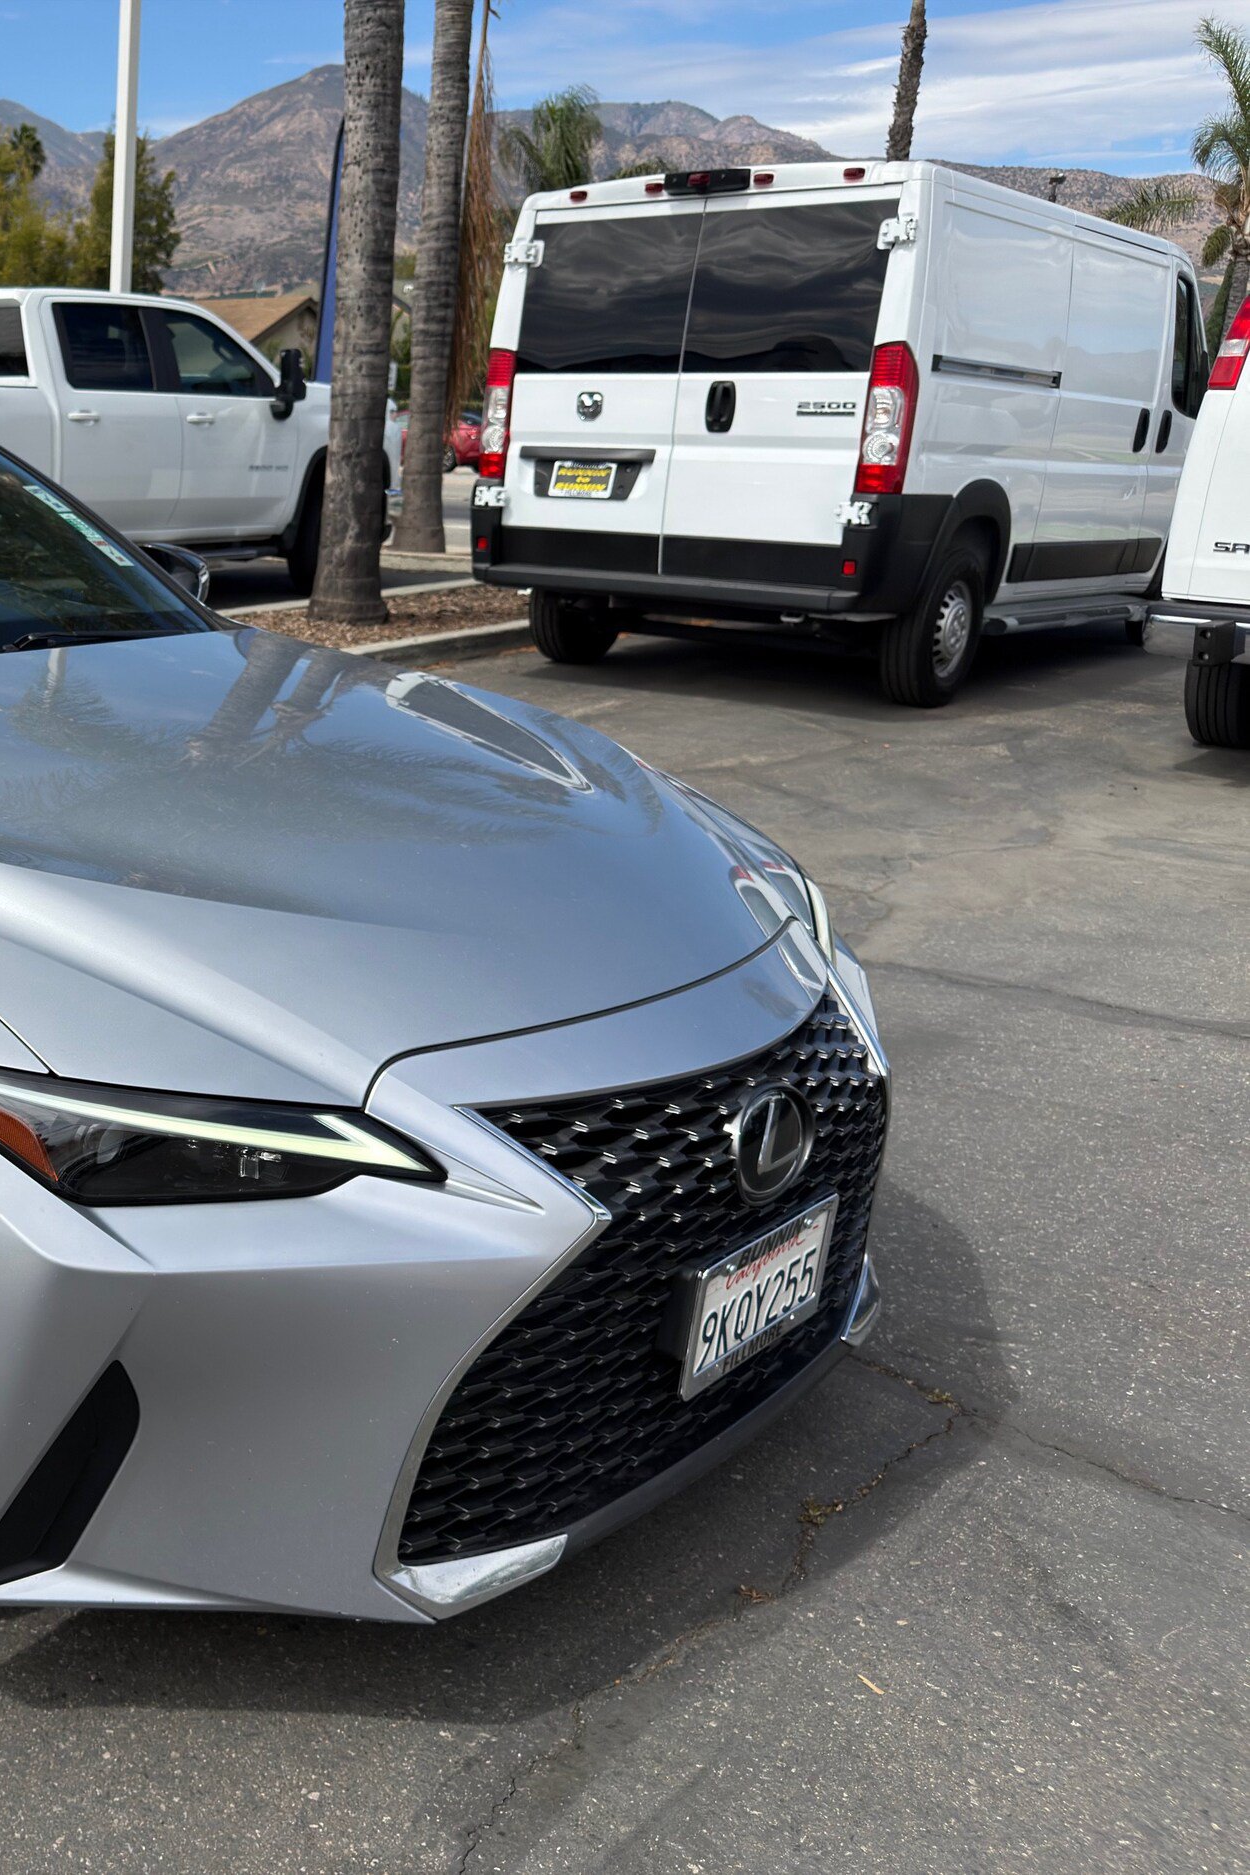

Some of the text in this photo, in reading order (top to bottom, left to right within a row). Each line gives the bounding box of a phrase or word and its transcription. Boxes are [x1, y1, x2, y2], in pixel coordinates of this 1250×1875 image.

[797, 402, 857, 410] 2500
[736, 1211, 806, 1267] BUNNIN
[694, 1247, 817, 1376] 9KQY255
[722, 1322, 784, 1375] FILLMORE
